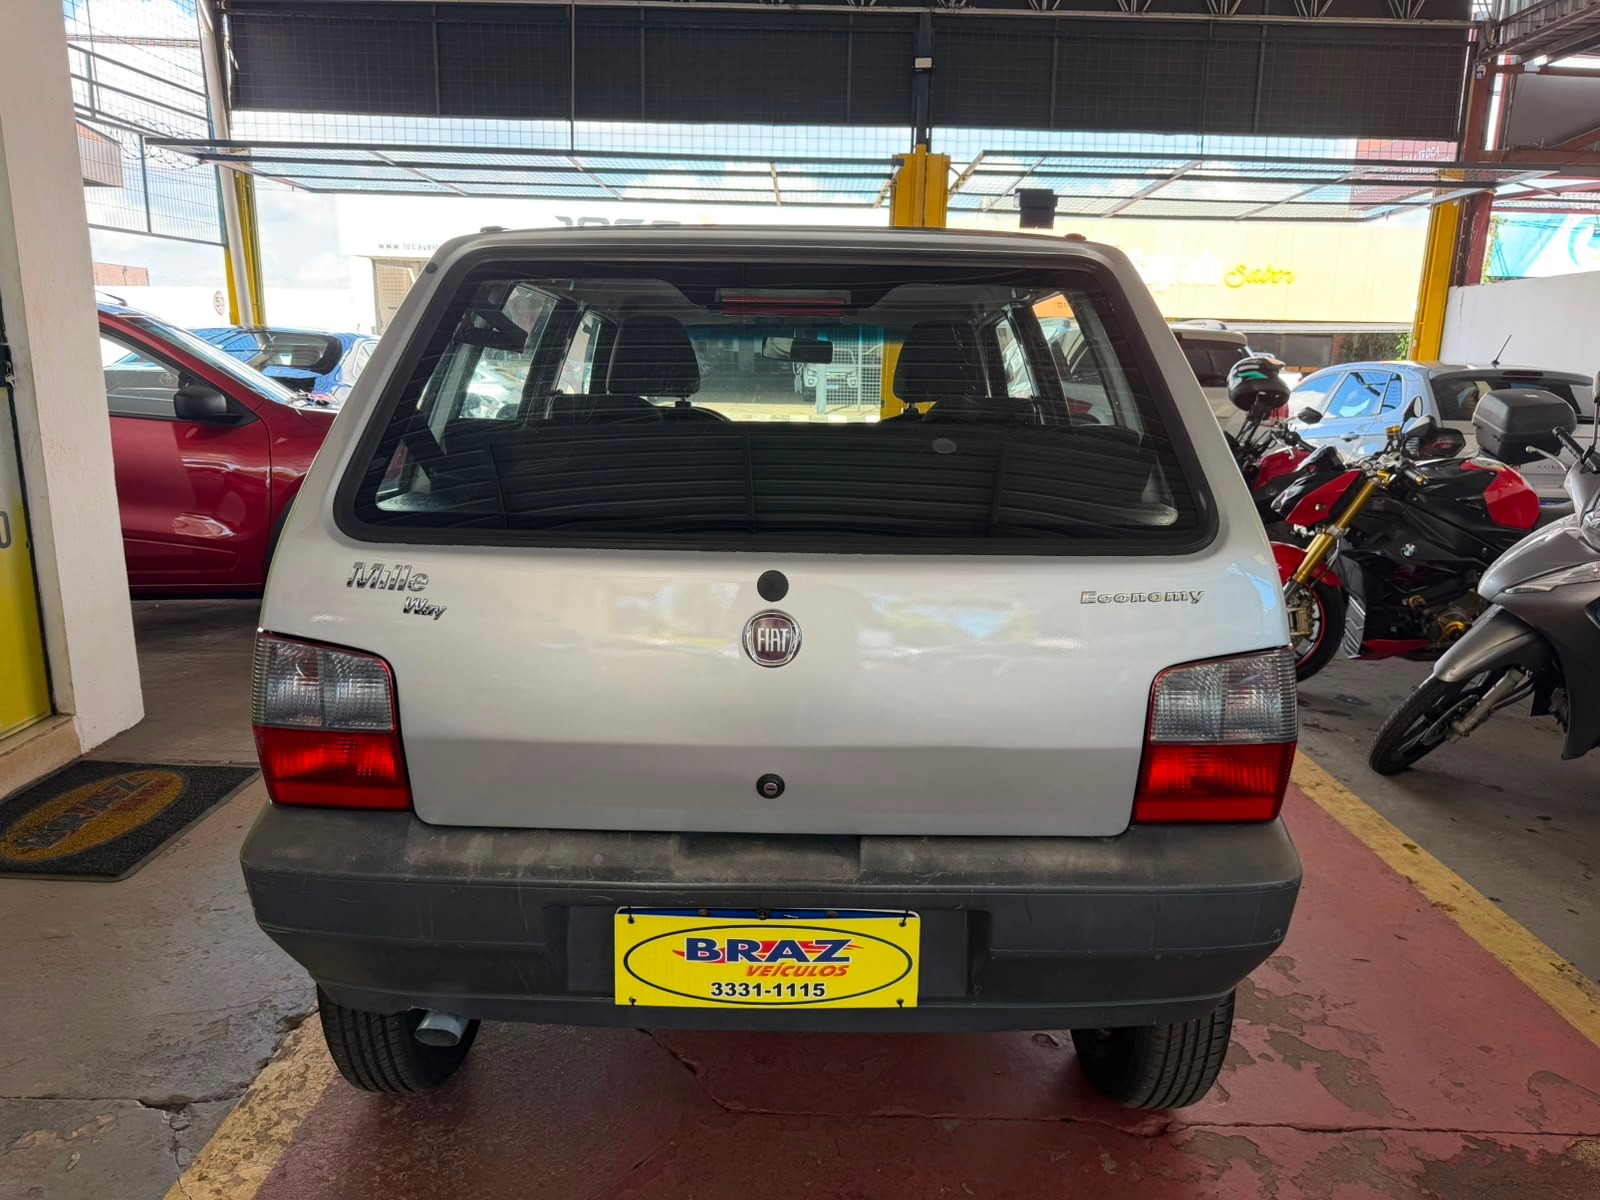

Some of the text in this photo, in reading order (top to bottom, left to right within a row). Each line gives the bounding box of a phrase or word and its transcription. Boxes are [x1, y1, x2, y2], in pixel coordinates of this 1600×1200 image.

[346, 561, 429, 592] Mille
[402, 596, 448, 621] Way
[1080, 590, 1205, 605] Economy
[757, 627, 789, 652] FIAT
[685, 937, 852, 963] BRAZ
[746, 962, 849, 977] VEÍCULOS
[711, 982, 826, 998] 3331-1115
